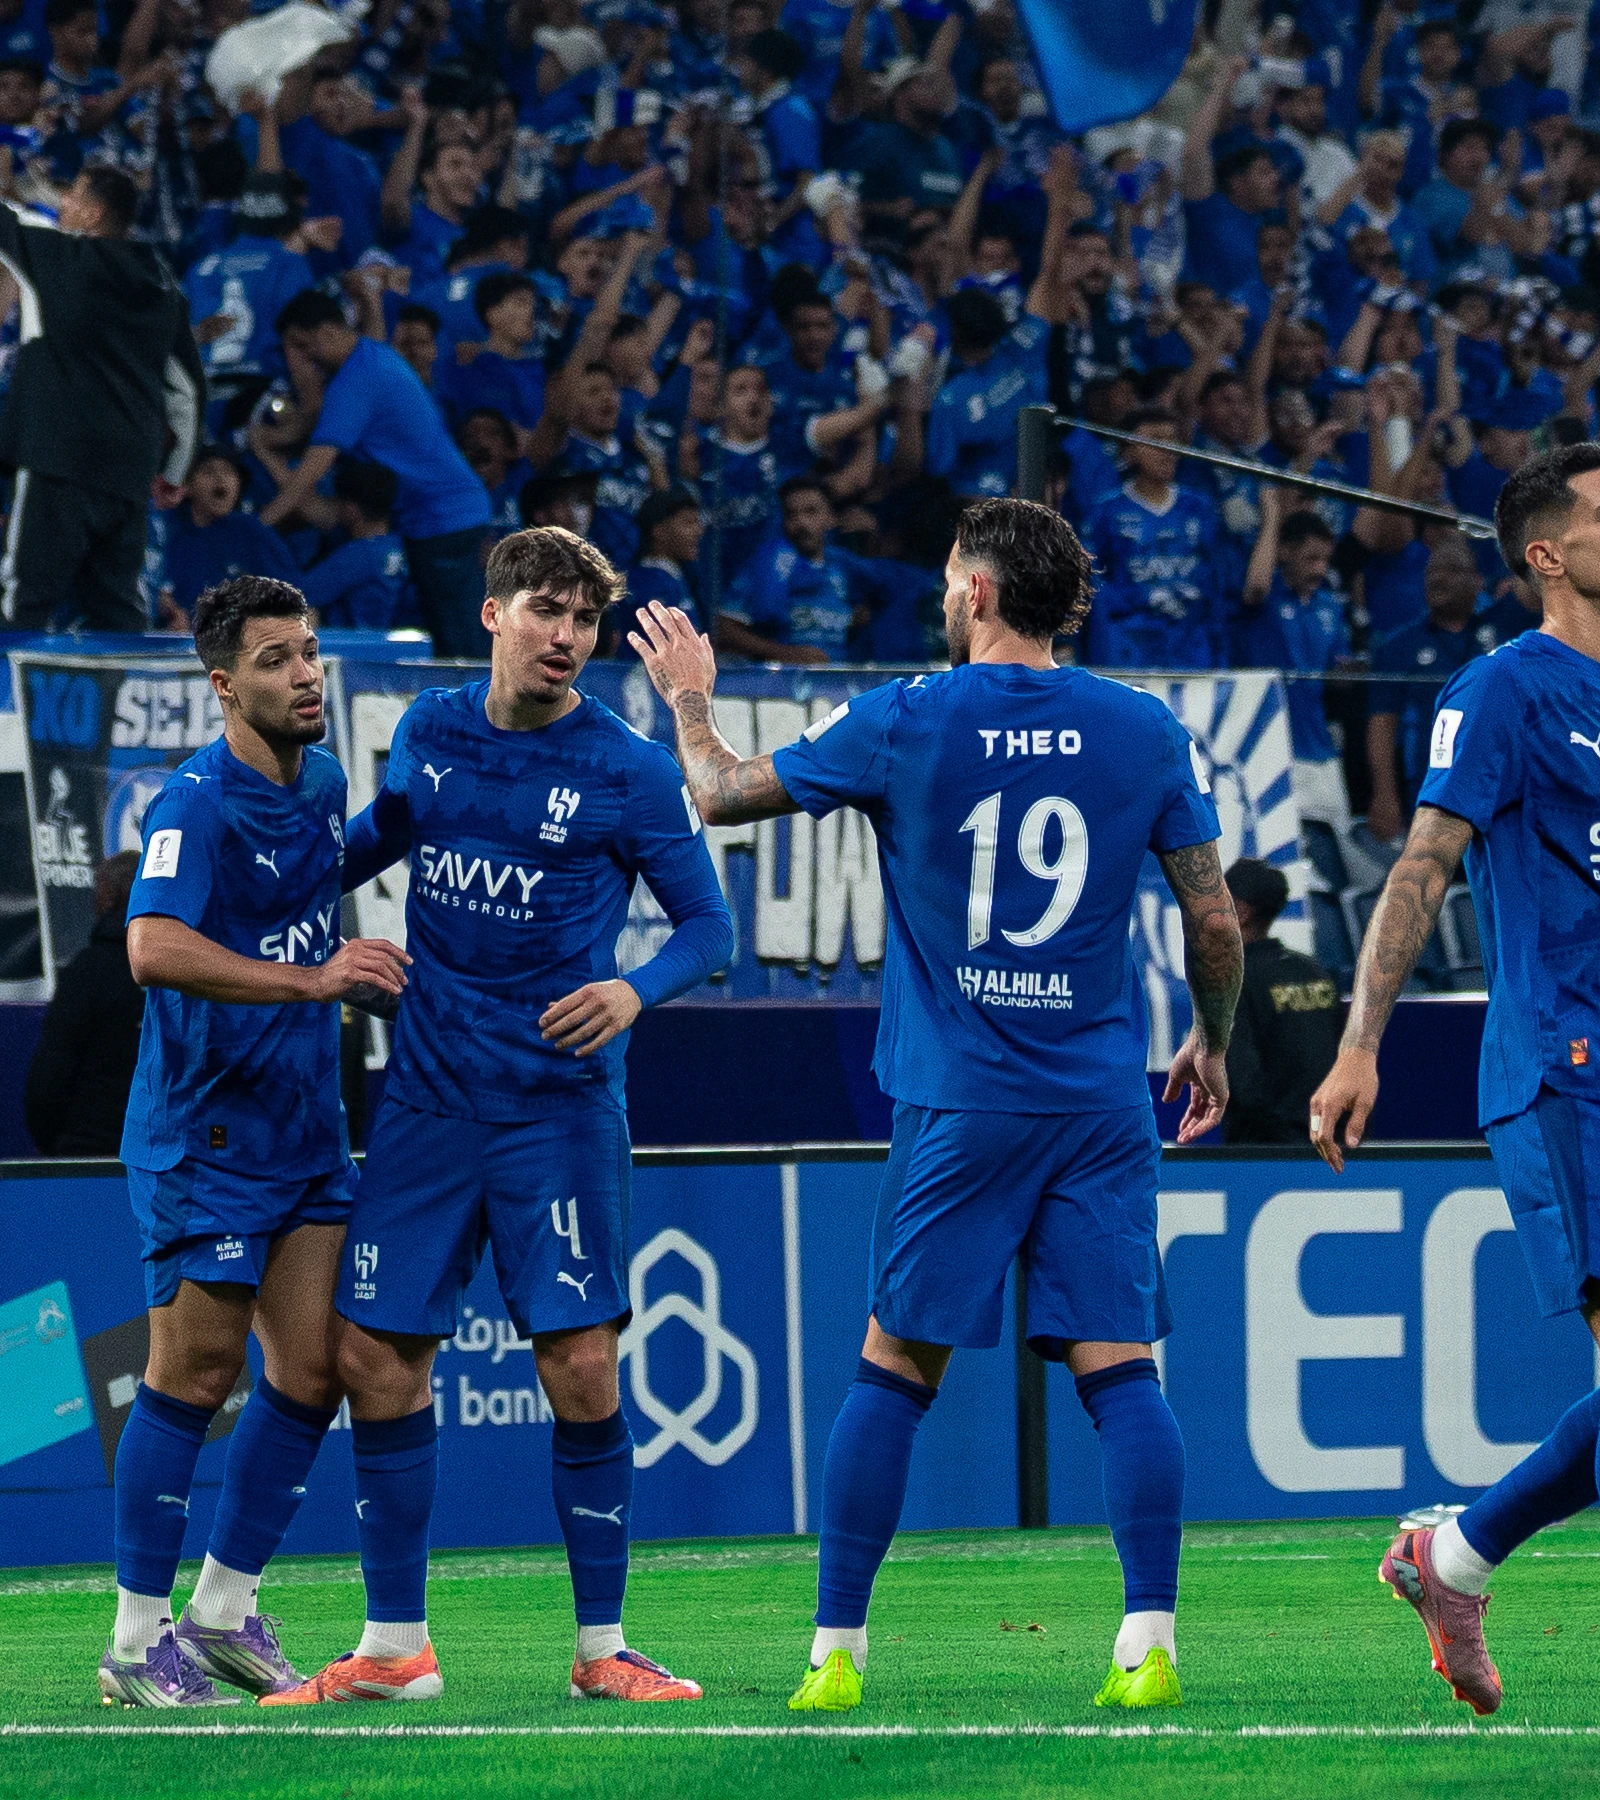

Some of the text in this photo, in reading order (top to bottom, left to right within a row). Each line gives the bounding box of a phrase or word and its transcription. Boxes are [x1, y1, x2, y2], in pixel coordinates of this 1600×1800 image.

[977, 729, 1082, 759] THEO
[420, 844, 544, 904] SAVVY
[957, 790, 1089, 952] 19
[416, 882, 535, 922] GAMES GROUP
[982, 994, 1073, 1010] FOUNDATION
[984, 969, 1073, 997] ALHILAL
[551, 1196, 589, 1260] 4
